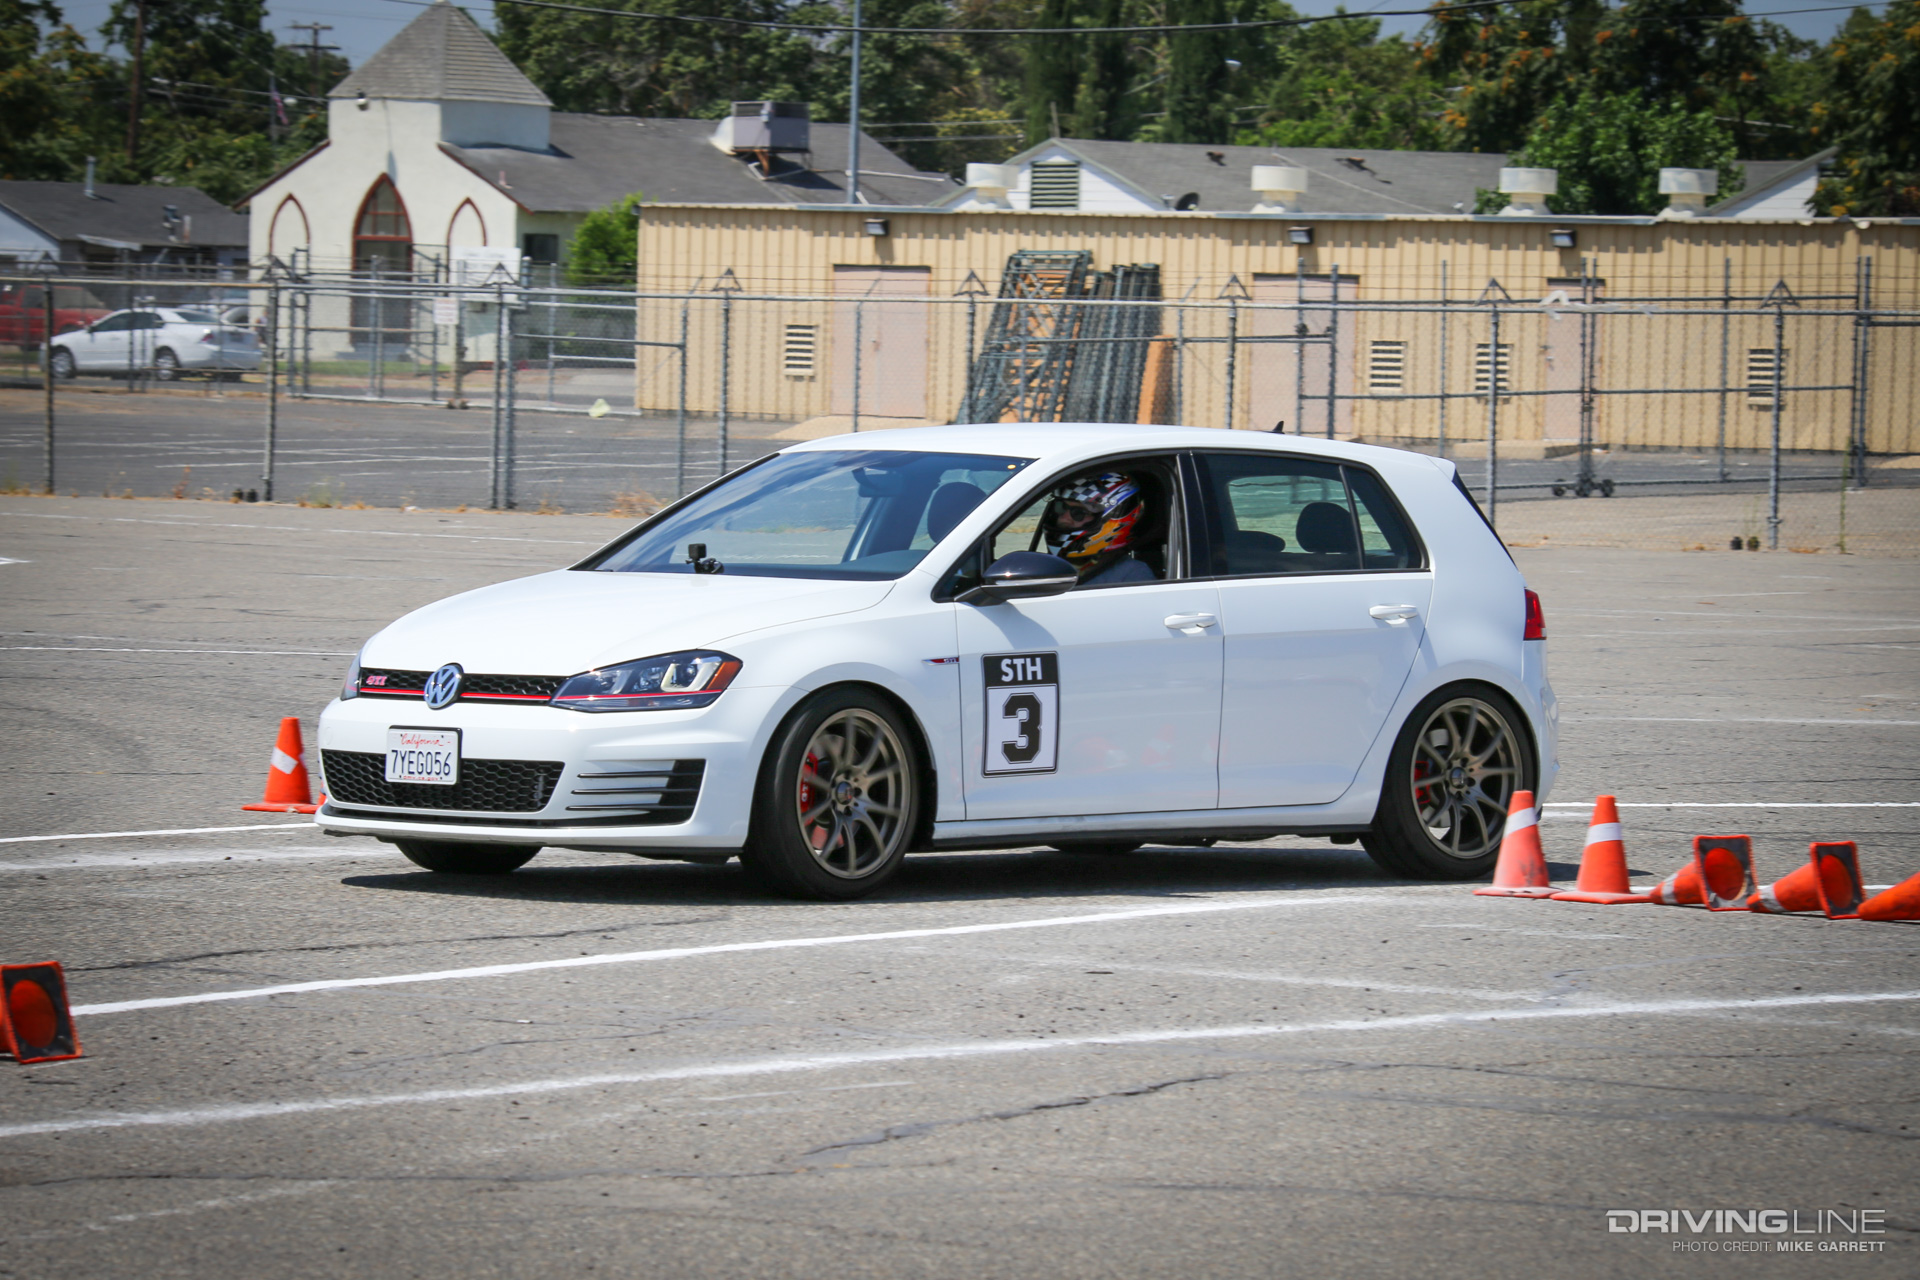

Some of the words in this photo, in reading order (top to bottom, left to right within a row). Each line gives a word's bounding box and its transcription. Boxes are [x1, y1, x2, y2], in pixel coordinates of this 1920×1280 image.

[366, 675, 388, 686] GTI
[1001, 657, 1042, 682] STH
[1001, 692, 1042, 764] 3
[401, 733, 444, 749] California
[391, 749, 451, 776] 7YEG056
